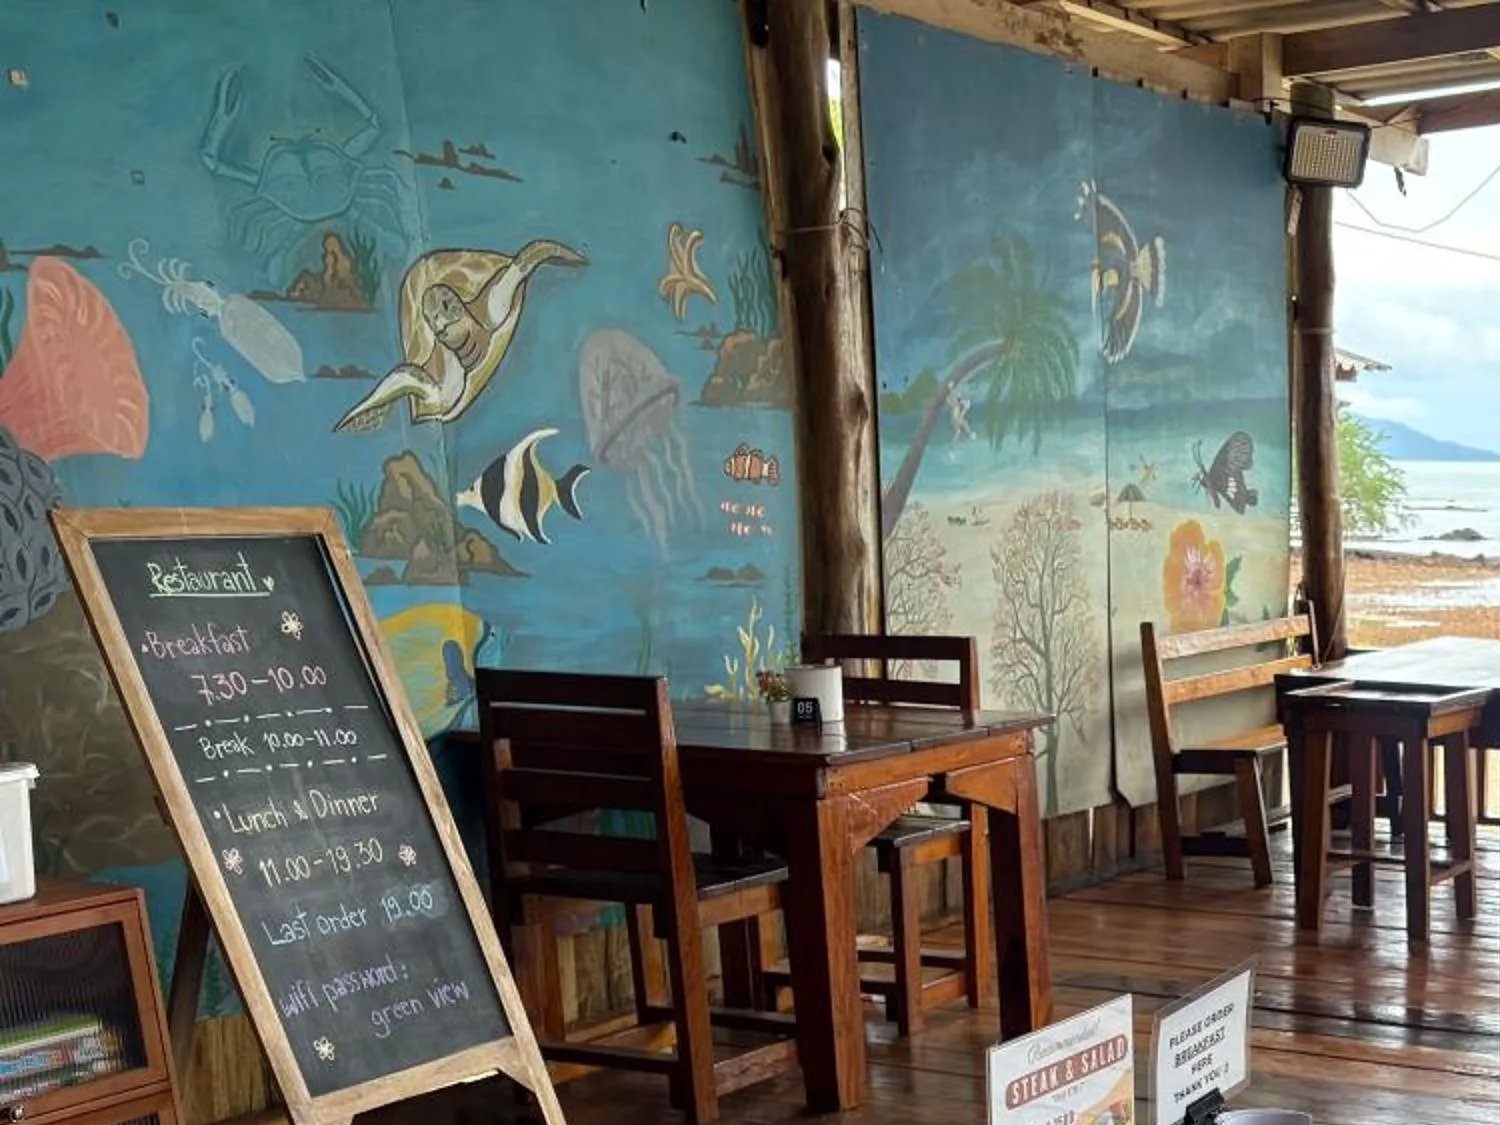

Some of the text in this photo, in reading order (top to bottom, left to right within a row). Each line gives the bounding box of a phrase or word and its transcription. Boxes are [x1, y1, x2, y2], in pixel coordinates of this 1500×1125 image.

[147, 552, 256, 592] Restaurant
[145, 622, 249, 659] Breakfast
[797, 701, 813, 714] 05
[199, 732, 254, 759] Break
[222, 796, 288, 834] Lunch
[309, 789, 378, 819] Dinner
[262, 905, 310, 945] Last
[317, 903, 367, 935] order
[371, 977, 470, 1038] green view
[1169, 1003, 1234, 1049] PLEASE ORDER
[1174, 1026, 1226, 1067] BREAKFAST
[1192, 1053, 1213, 1074] HERE
[1012, 1065, 1059, 1104] STEAK
[1065, 1058, 1074, 1080] &
[1081, 1037, 1125, 1074] SALAD
[1174, 1078, 1202, 1103] THANK
